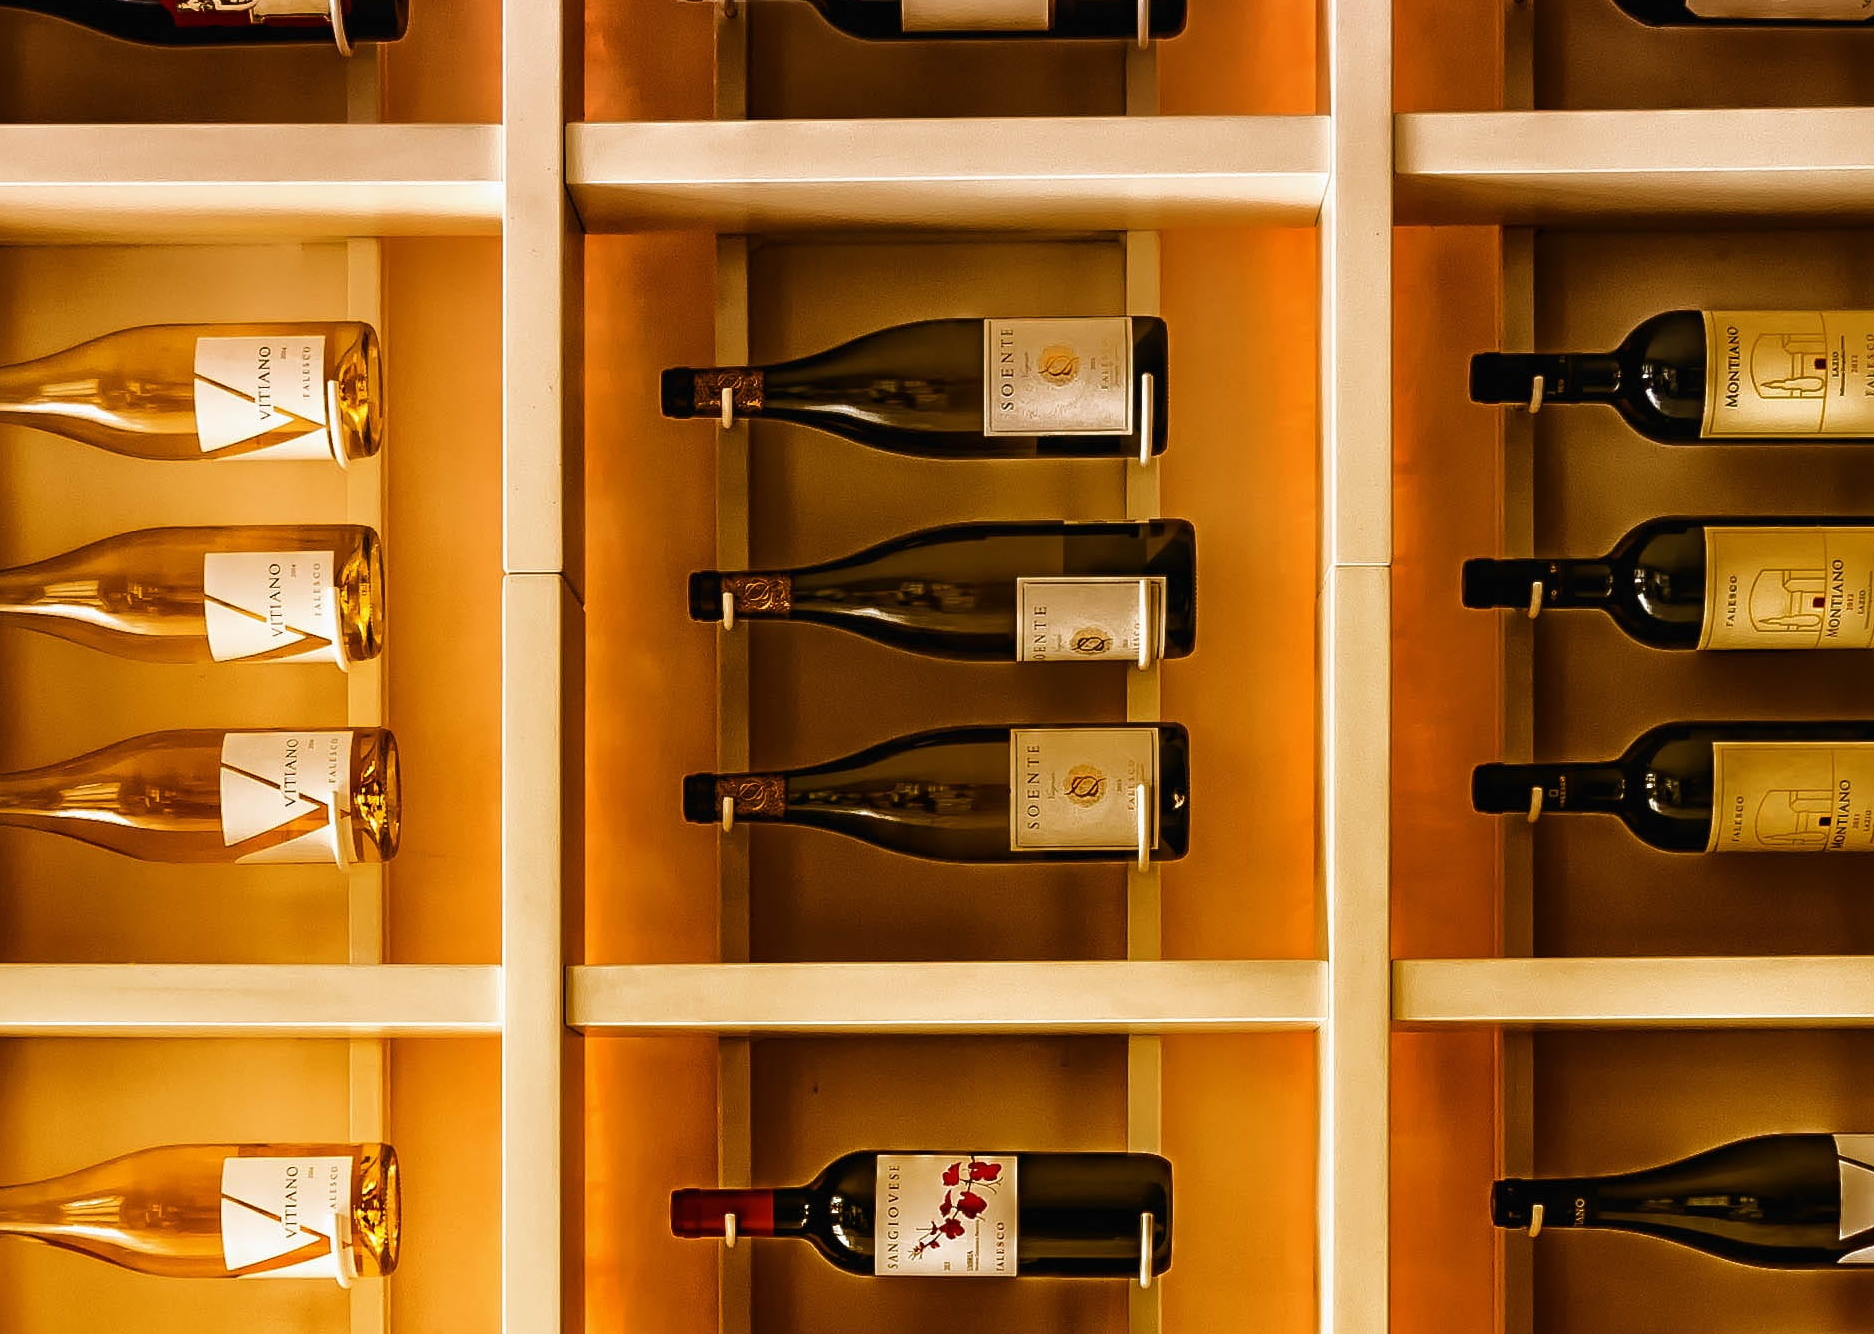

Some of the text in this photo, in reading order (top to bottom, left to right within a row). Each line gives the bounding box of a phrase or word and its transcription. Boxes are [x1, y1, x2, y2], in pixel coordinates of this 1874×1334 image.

[258, 346, 272, 420] VITIANO
[301, 346, 311, 398] FALESCO
[1000, 329, 1015, 411] SOENTE
[1724, 325, 1741, 409] MONTIANO
[1831, 351, 1839, 378] LAZIO
[268, 563, 283, 638] VITIANO
[313, 563, 322, 617] FALESCO
[1725, 575, 1738, 627] FALESCO
[1826, 559, 1845, 639] MONTIANO
[1857, 589, 1867, 616] LAZIO
[285, 739, 299, 807] VITIANO
[327, 738, 339, 784] FALESCO
[1026, 745, 1041, 830] SOENTE
[1731, 795, 1744, 843] FALESCO
[1830, 779, 1851, 849] MONTIANO
[1863, 809, 1873, 833] LAZIO
[285, 1166, 299, 1239] VITIANO
[887, 1164, 900, 1269] SANGIOVESE
[996, 1222, 1006, 1272] FALESCO
